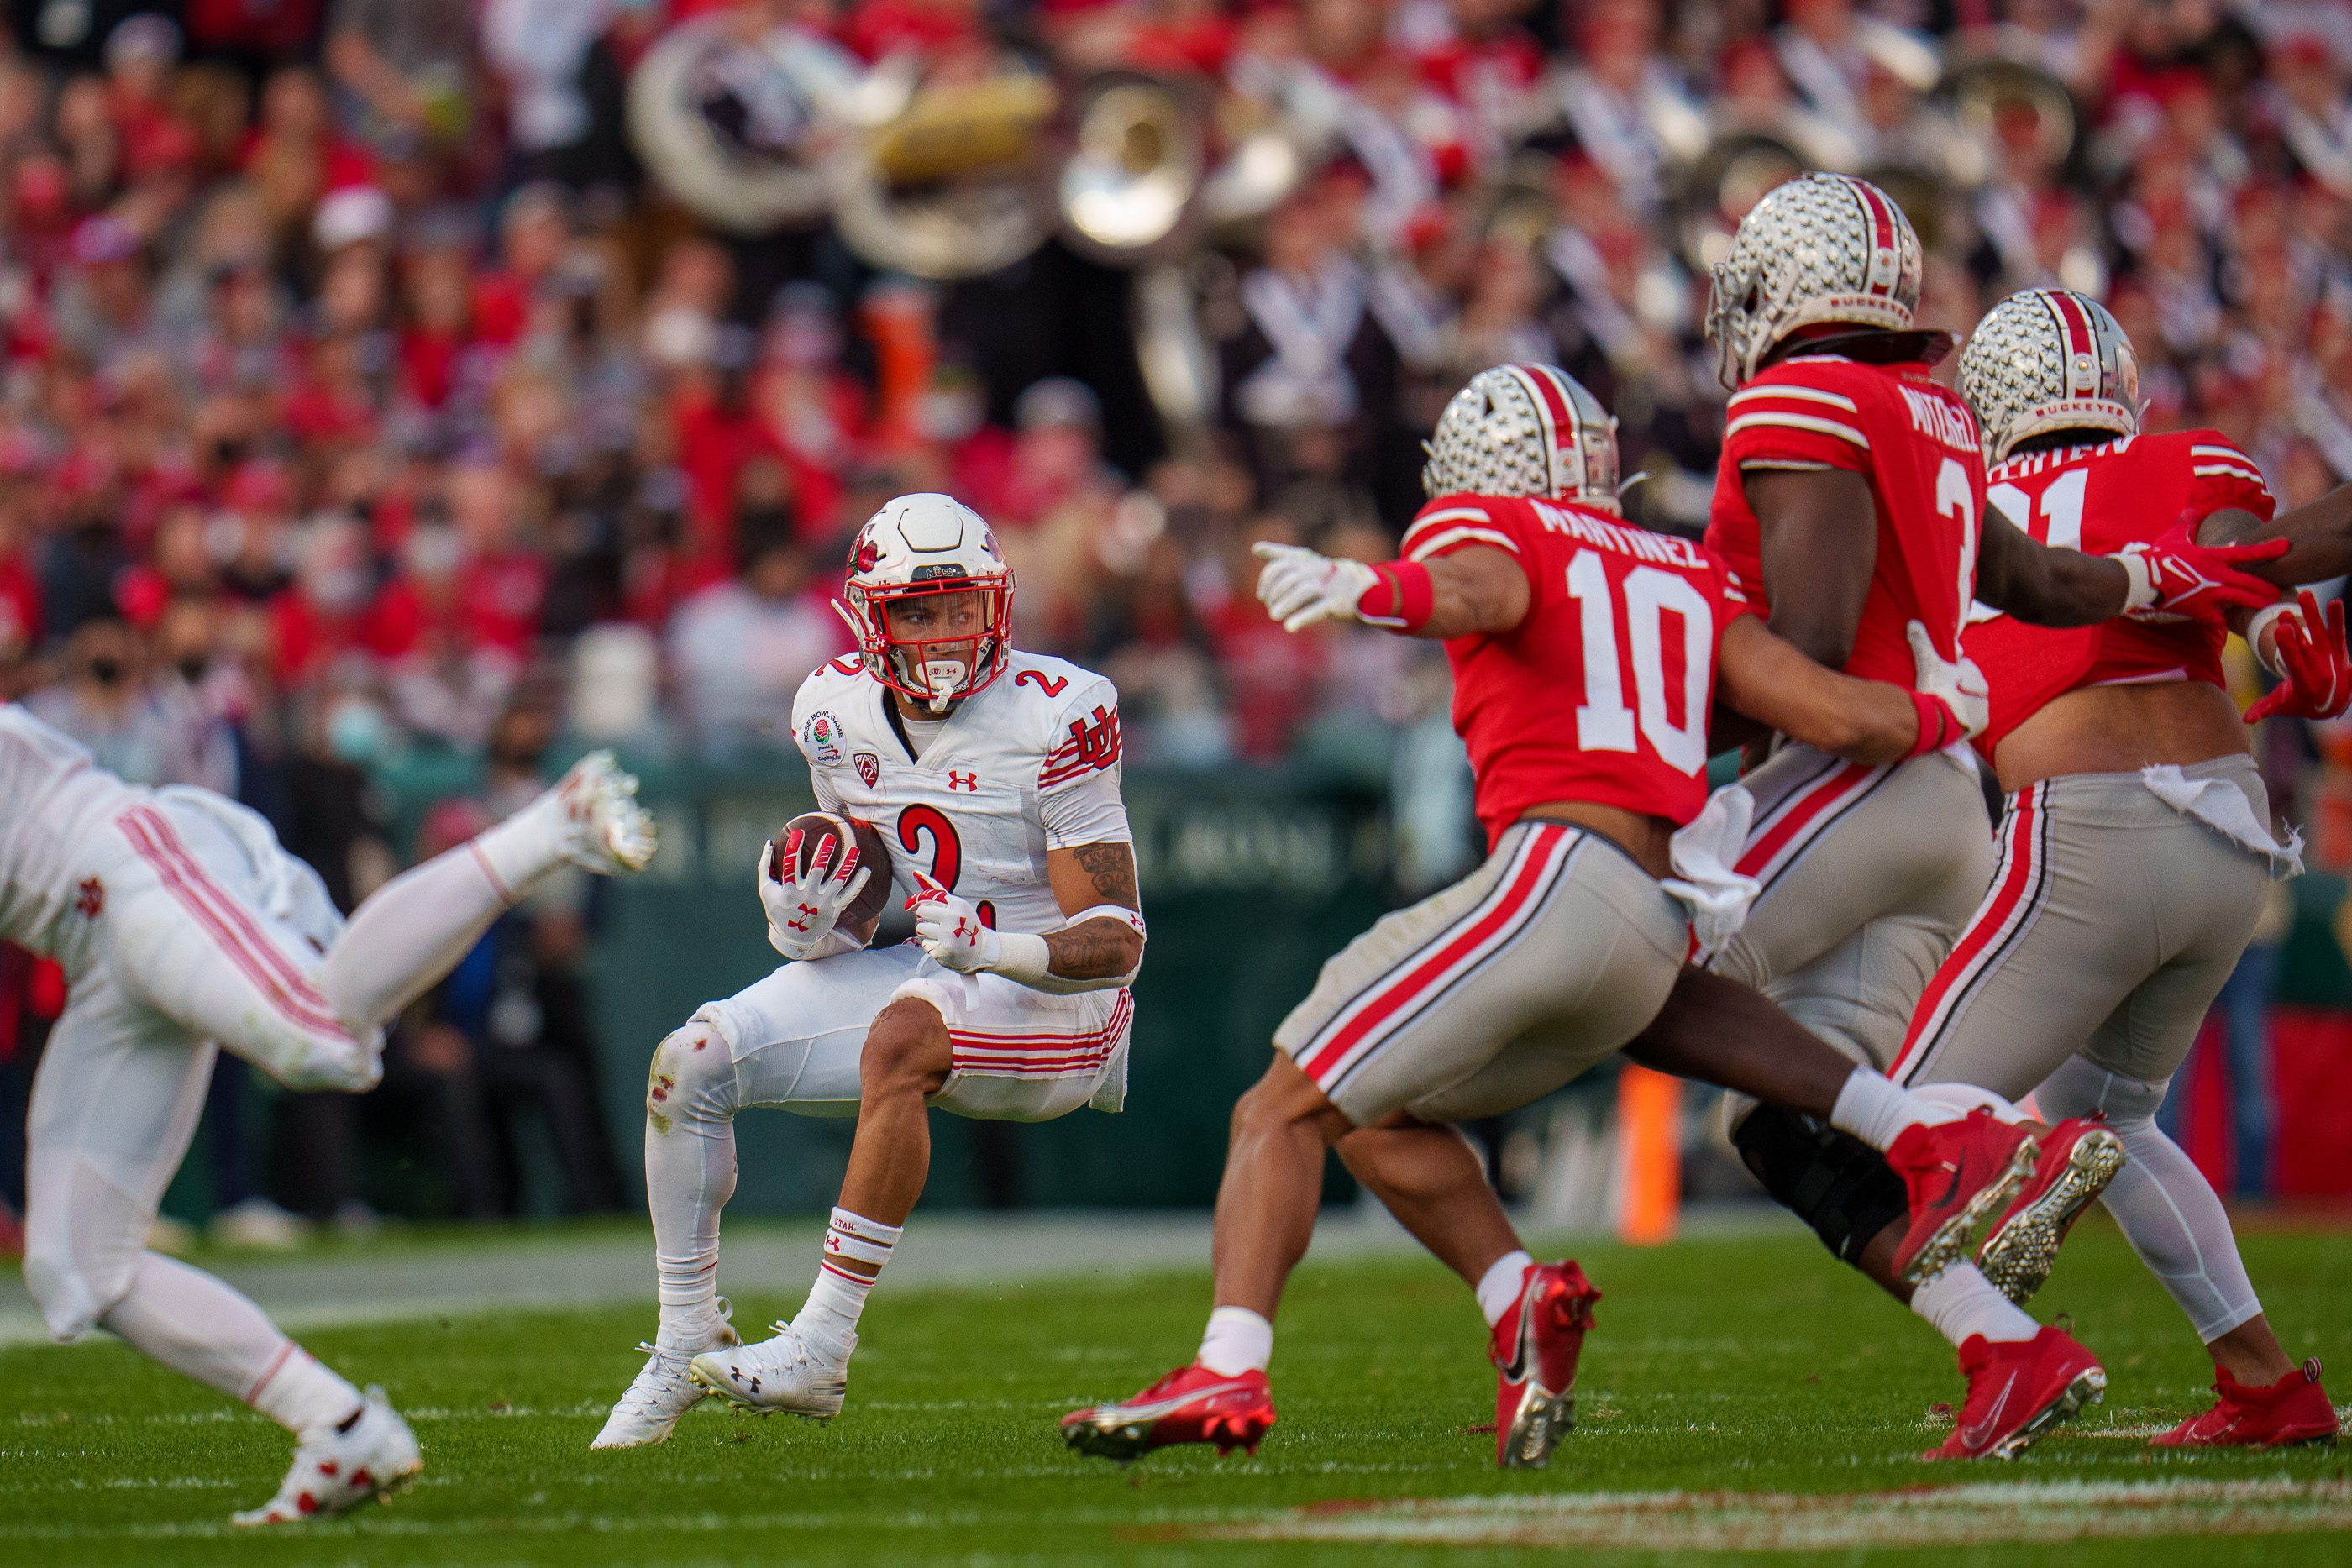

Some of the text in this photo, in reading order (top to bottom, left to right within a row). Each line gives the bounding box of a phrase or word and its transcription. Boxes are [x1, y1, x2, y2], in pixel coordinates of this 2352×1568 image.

[2035, 402, 2124, 417] BUCKEYES
[1529, 498, 1710, 569] MARTINEZ
[1936, 455, 1976, 657] 3
[1565, 547, 1714, 779] 10
[1015, 669, 1068, 698] 2
[804, 711, 844, 743] ROSE BOWL GAME
[854, 754, 878, 774] PAC
[863, 767, 875, 780] 12
[835, 1218, 854, 1230] UTAH
